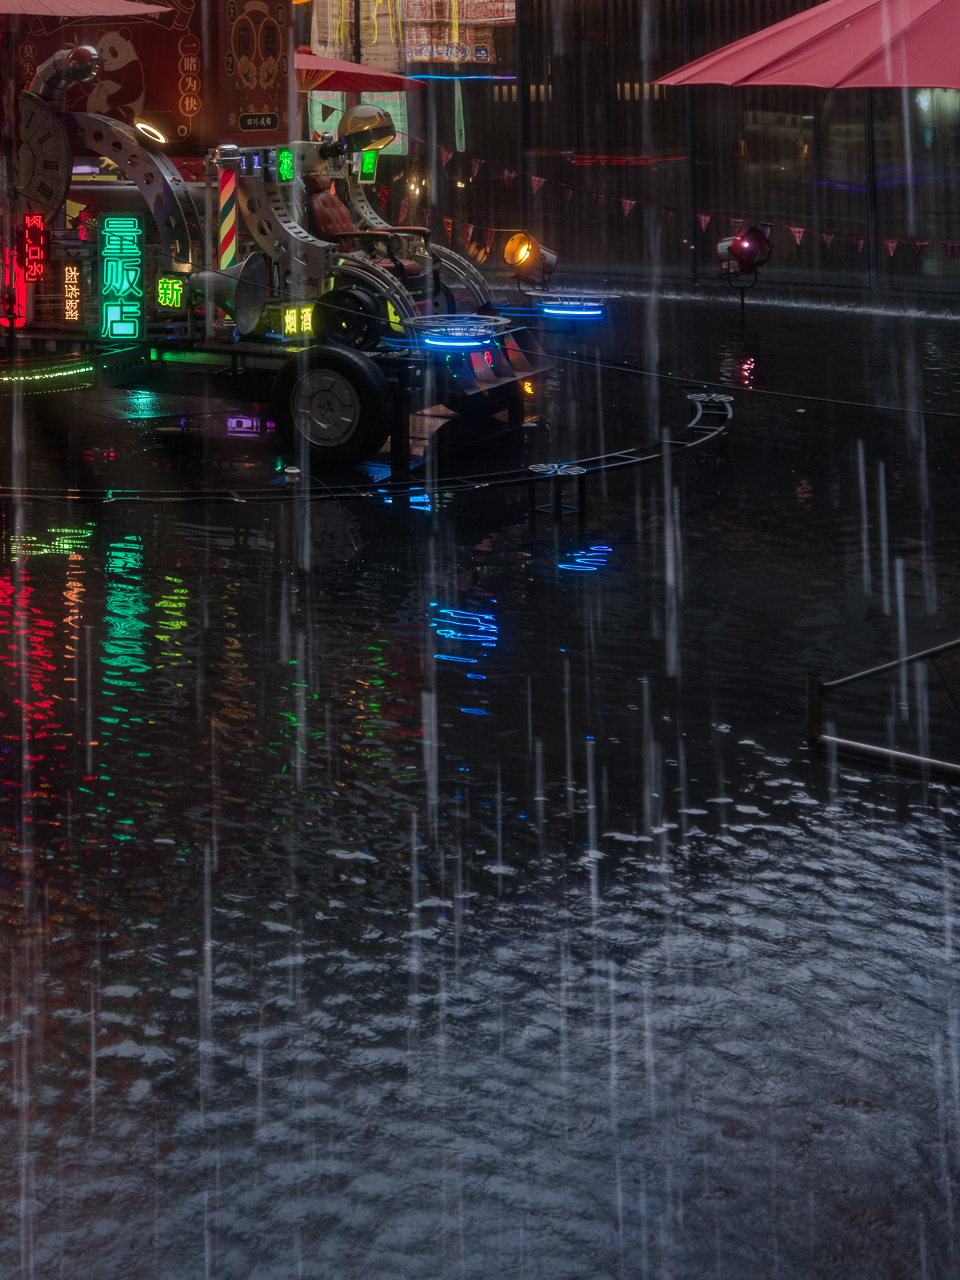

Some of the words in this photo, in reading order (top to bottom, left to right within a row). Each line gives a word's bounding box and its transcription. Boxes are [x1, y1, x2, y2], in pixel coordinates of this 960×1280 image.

[183, 43, 198, 111] 一睹为快
[279, 150, 294, 181] 花
[101, 217, 143, 339] 量贩店
[158, 277, 183, 308] 新
[284, 306, 313, 334] 烟酒
